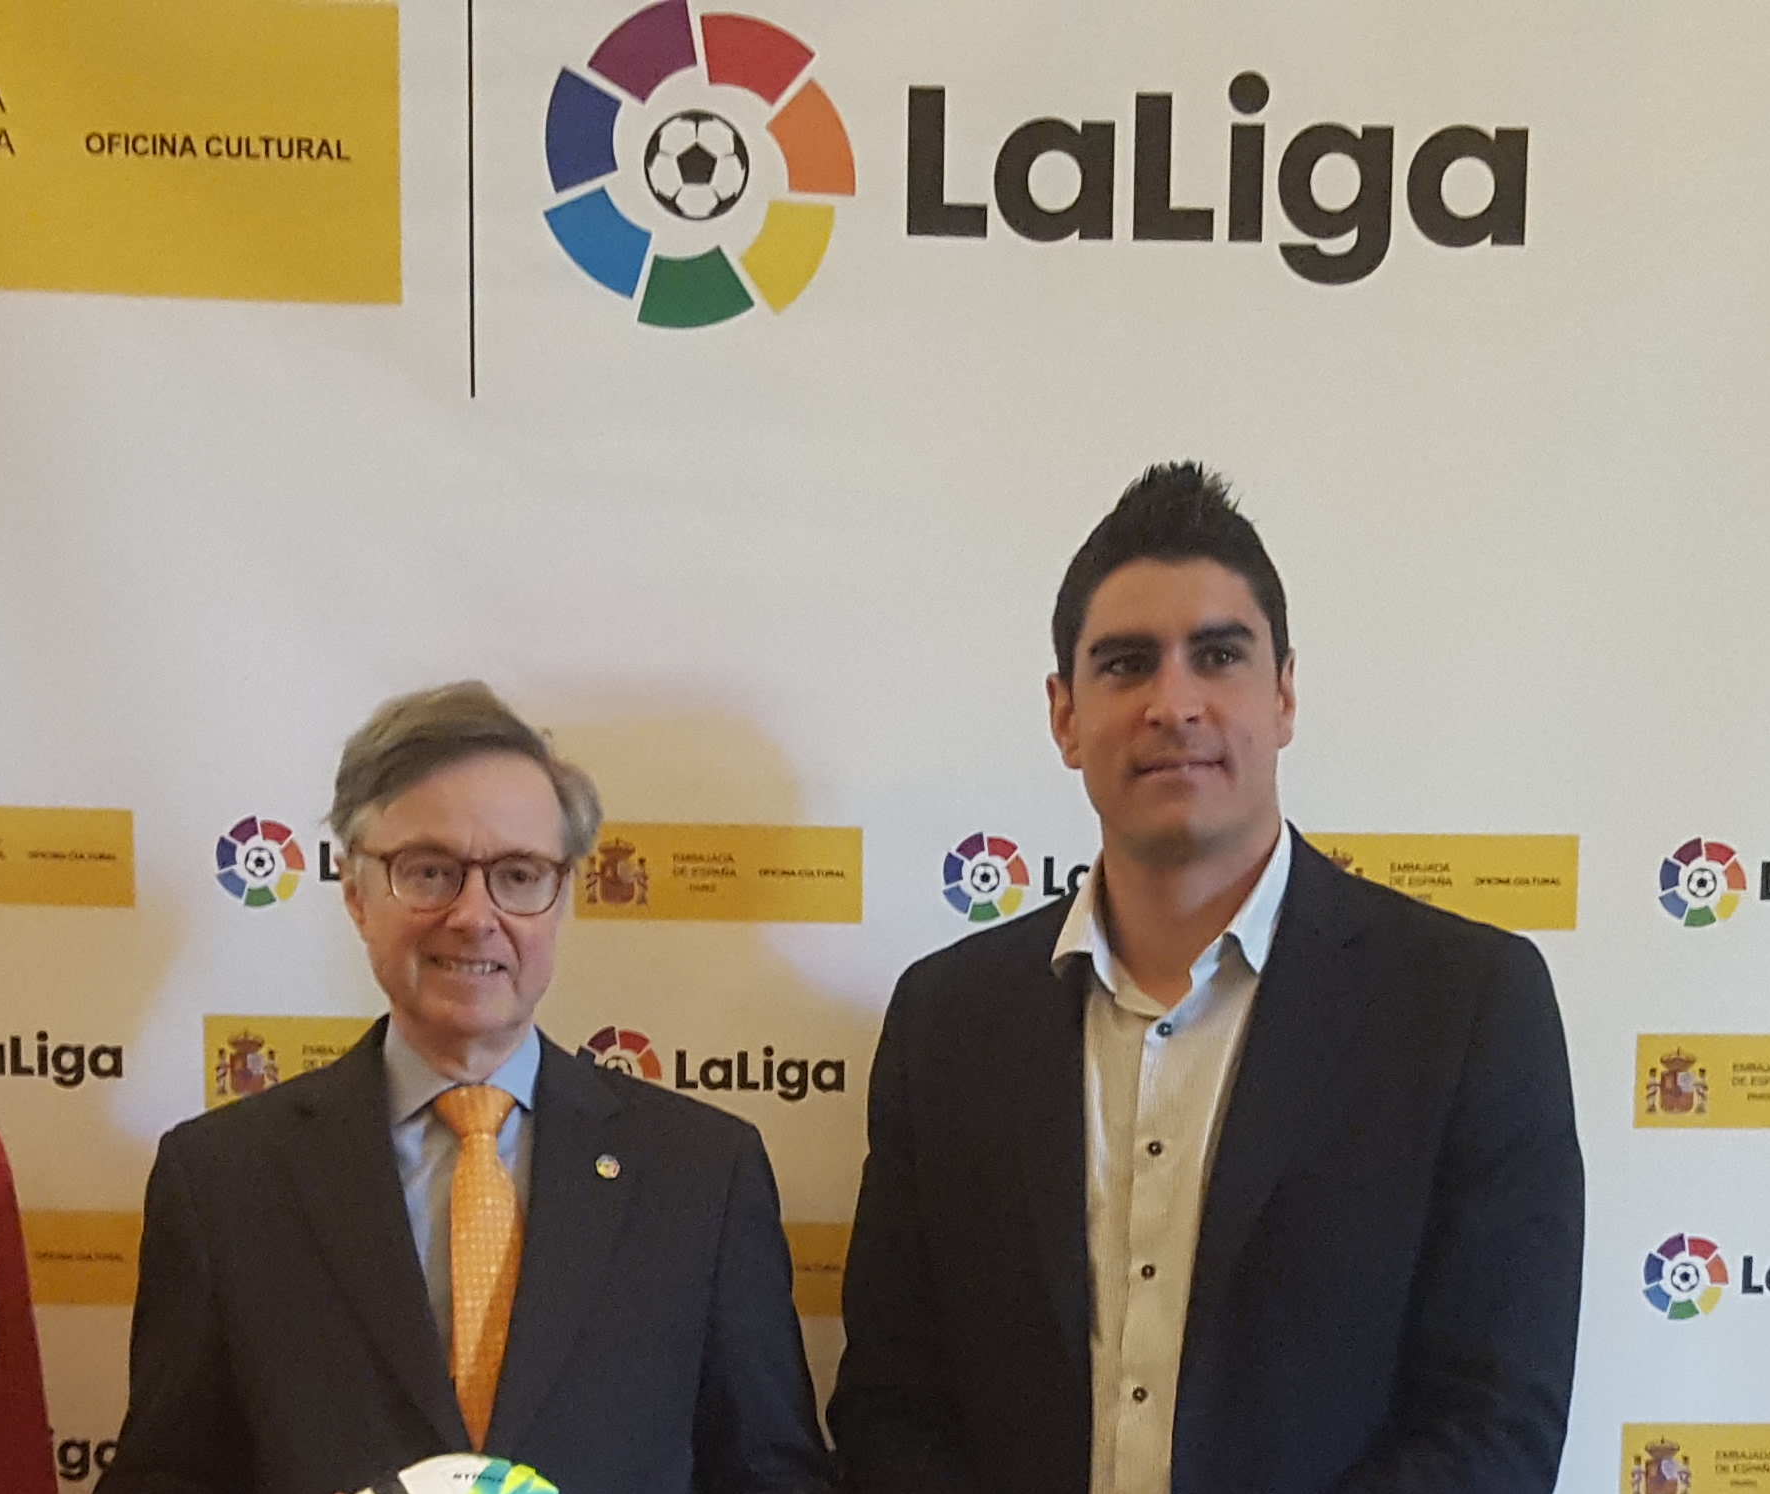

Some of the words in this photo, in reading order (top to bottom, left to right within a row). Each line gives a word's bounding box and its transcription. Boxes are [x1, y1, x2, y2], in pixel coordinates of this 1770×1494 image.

[85, 132, 197, 158] OFICINA
[205, 135, 350, 162] CULTURAL
[906, 71, 1529, 285] LaLiga
[676, 1046, 845, 1101] LaLiga
